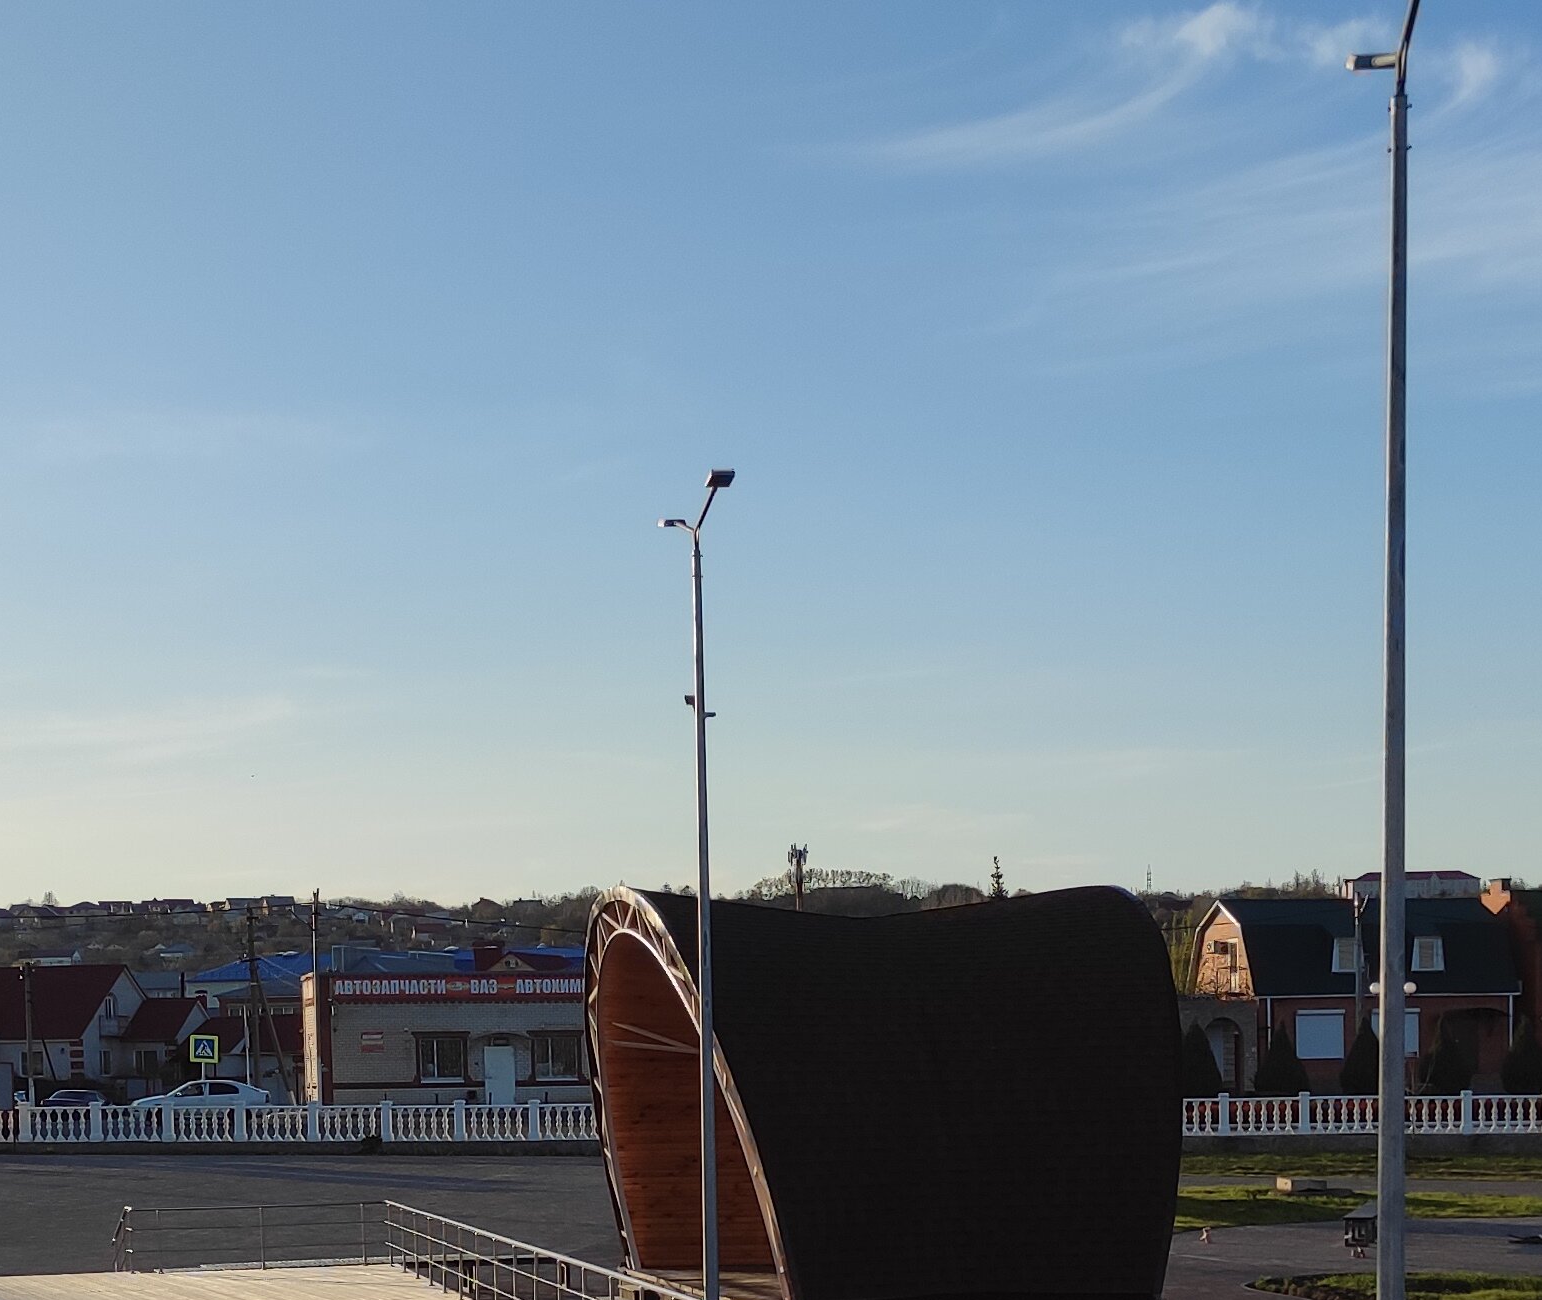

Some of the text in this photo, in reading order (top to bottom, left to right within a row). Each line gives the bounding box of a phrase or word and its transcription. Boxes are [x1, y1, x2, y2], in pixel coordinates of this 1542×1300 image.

[334, 978, 585, 995] АВТОЗАПЧАСТИ ВАЗ АВТОХИМ
